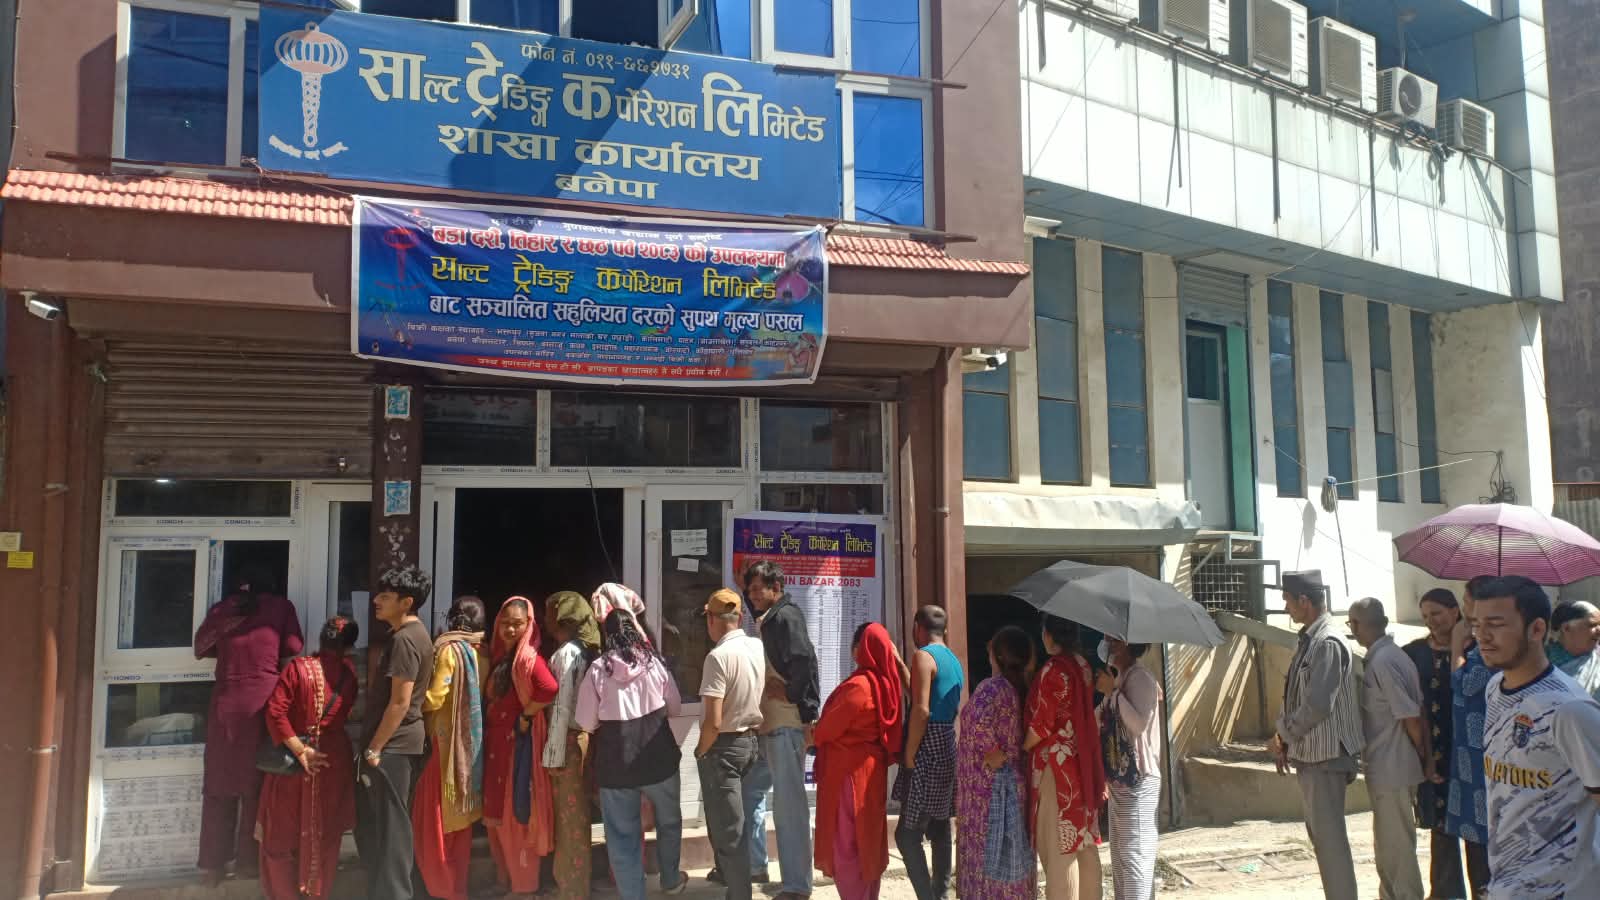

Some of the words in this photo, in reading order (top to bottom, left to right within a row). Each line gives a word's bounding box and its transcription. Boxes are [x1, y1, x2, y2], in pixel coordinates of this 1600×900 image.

[521, 41, 556, 62] फोन
[562, 48, 579, 65] नं.
[358, 47, 462, 103] साल्ट
[465, 41, 554, 128] ट्रेडिङ्ग
[562, 72, 698, 129] कर्पोरेशन
[702, 72, 826, 142] लिमिटेड
[438, 124, 560, 161] शाखा
[575, 138, 762, 181] कार्यालय
[555, 171, 660, 199] बनेपा
[432, 226, 467, 246] बडा
[508, 229, 557, 253] तिहार
[559, 236, 574, 254] र
[577, 236, 609, 256] छठ
[611, 236, 636, 258] पर्व
[637, 242, 679, 262] २०८३
[684, 241, 706, 263] को
[430, 255, 490, 283] साल्ट
[703, 267, 777, 300] लिमिटेड
[429, 295, 462, 315] बाट
[466, 294, 549, 319] सञ्चालित
[553, 298, 628, 327] सहुलियत
[632, 303, 675, 326] दरको
[680, 308, 720, 330] सुपथ
[724, 310, 760, 334] मूल्य
[765, 312, 804, 331] पसल
[800, 577, 835, 587] BAZAR
[837, 578, 862, 588] 2083
